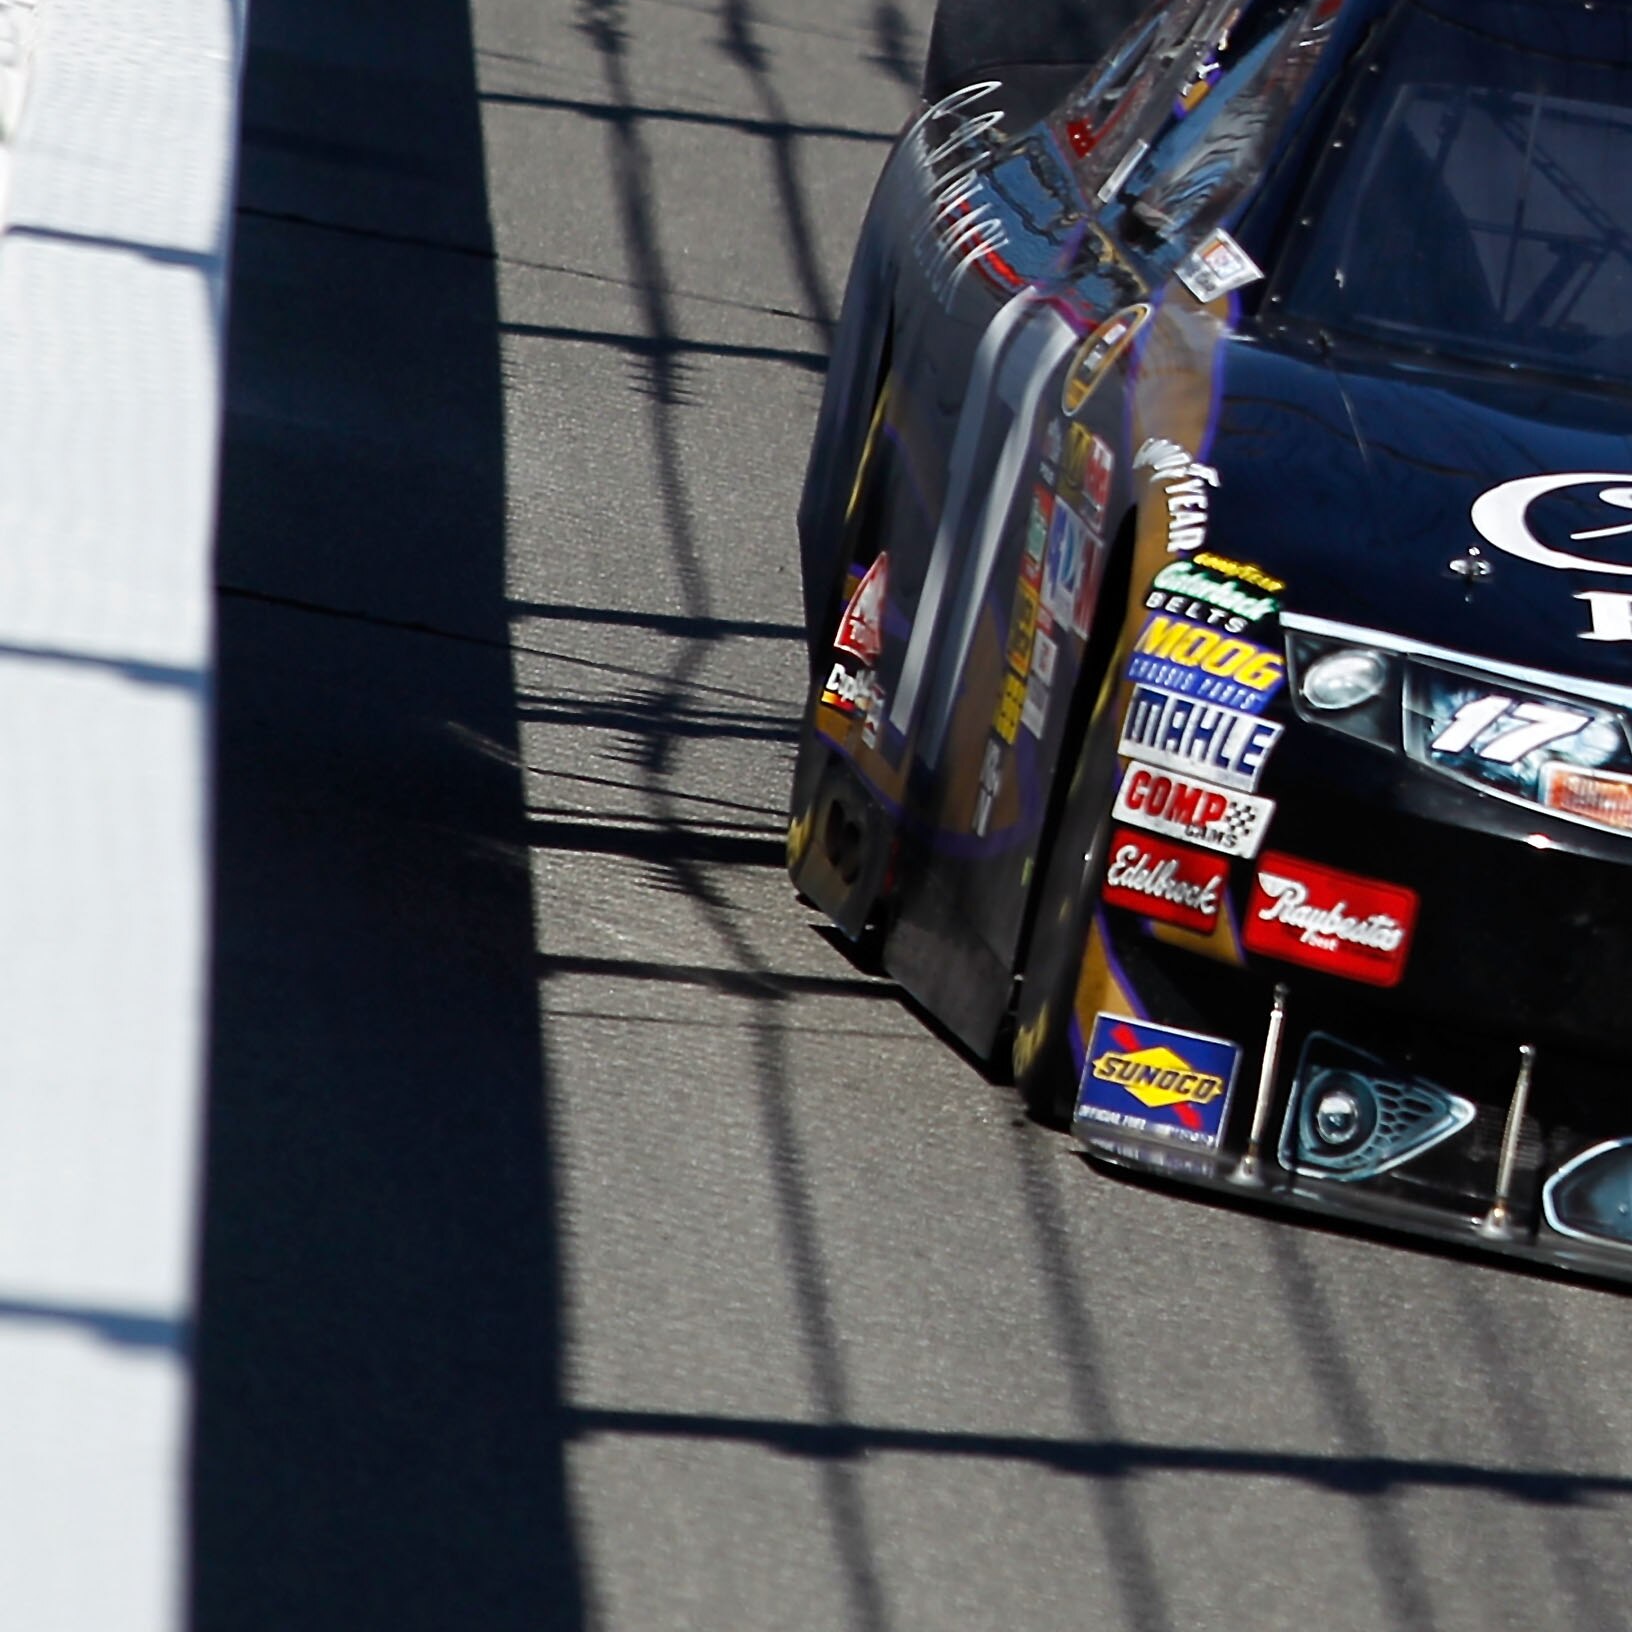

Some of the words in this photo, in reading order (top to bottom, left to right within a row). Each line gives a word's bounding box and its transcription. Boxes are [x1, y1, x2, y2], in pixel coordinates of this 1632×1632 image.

[1146, 591, 1248, 634] BELTS
[1128, 657, 1195, 691] CHASSIS
[1197, 677, 1258, 710] PARTS
[1134, 615, 1285, 691] MOOG
[1124, 687, 1277, 777] MAHLE
[1430, 694, 1595, 765] 17
[1124, 769, 1228, 827] COMP
[1184, 823, 1239, 848] CAMS
[1107, 844, 1223, 915] Edelbrock
[1258, 871, 1405, 953] Raybestos
[1099, 1056, 1217, 1101] SUNOCO
